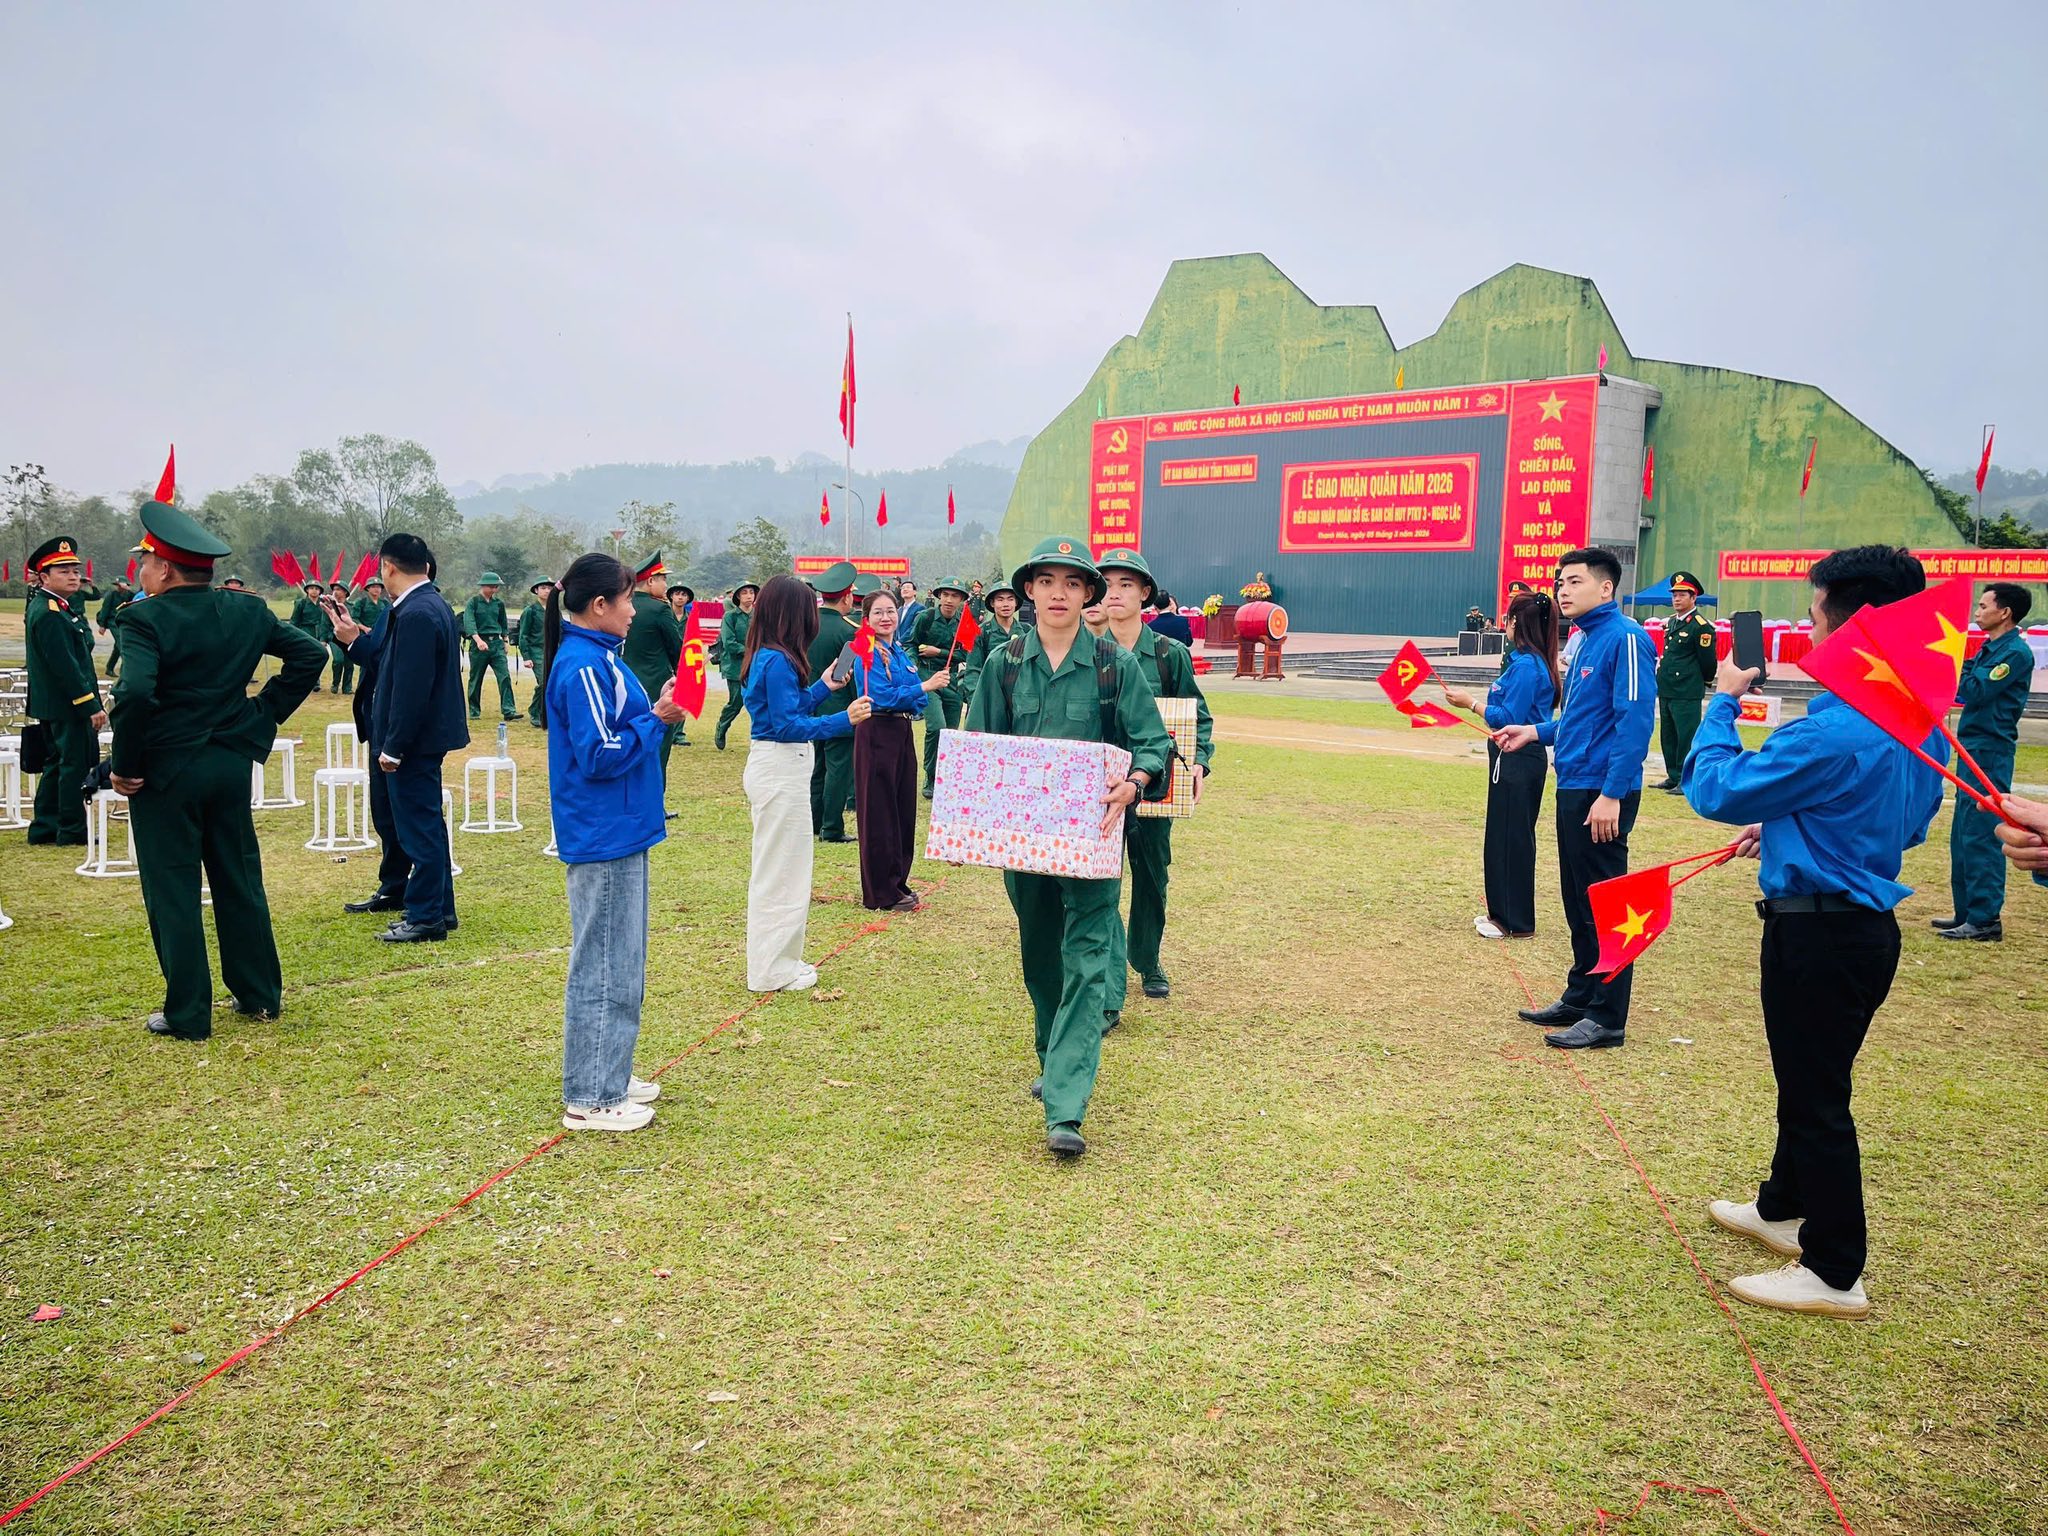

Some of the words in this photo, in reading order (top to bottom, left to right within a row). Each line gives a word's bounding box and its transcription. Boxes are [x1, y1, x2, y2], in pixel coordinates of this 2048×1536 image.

[1173, 419, 1197, 432] NƯỚC
[1200, 417, 1225, 433] CỘNG
[1228, 414, 1247, 428] HÒA
[1250, 412, 1263, 426] XÃ
[1265, 411, 1282, 426] HỘI
[1284, 409, 1304, 422] CHỦ
[1307, 405, 1339, 421] NGHĨA
[1342, 404, 1365, 420] VIỆT
[1367, 403, 1393, 416] NAM
[1396, 399, 1431, 414] MUÔN
[1433, 396, 1461, 410] NĂM
[1533, 434, 1564, 451] SỐNG,
[1224, 464, 1241, 477] THANH
[1519, 456, 1549, 473] CHIẾN
[1552, 454, 1576, 473] ĐẤU,
[1302, 471, 1314, 499] LỄ
[1315, 478, 1338, 499] GIAO
[1340, 472, 1368, 502] NHẬN
[1370, 470, 1398, 499] QUÂN
[1400, 469, 1425, 494] NĂM
[1427, 472, 1453, 494] 2026
[1521, 480, 1540, 495] LAO
[1542, 478, 1571, 496] ĐỘNG
[1307, 509, 1320, 524] GIAO
[1321, 506, 1336, 527] NHẬN
[1337, 506, 1352, 525] QUÂN
[1352, 503, 1361, 523] SỐ
[1371, 507, 1383, 523] BAN
[1384, 503, 1394, 522] CHỈ
[1395, 506, 1407, 522] HUY
[1422, 505, 1427, 521] 3
[1432, 505, 1448, 524] NGỌC
[1538, 500, 1552, 515] VÀ
[1522, 522, 1543, 539] HỌC
[1545, 520, 1566, 539] TẬP
[1513, 544, 1538, 558] THEO
[1523, 563, 1544, 579] BÁC
[1728, 556, 1740, 573] TẤT
[1741, 556, 1750, 573] CẢ
[1751, 557, 1758, 573] VÌ
[1759, 558, 1769, 575] SỰ
[1769, 557, 1794, 576] NGHIỆP
[1795, 557, 1809, 573] XÂY
[1940, 557, 1956, 576] VIỆT
[1957, 559, 1976, 574] NAM
[1977, 556, 1988, 574] XÃ
[1989, 556, 2003, 576] HỘI
[2004, 555, 2020, 574] CHỦ
[2021, 557, 2045, 574] NGHĨA
